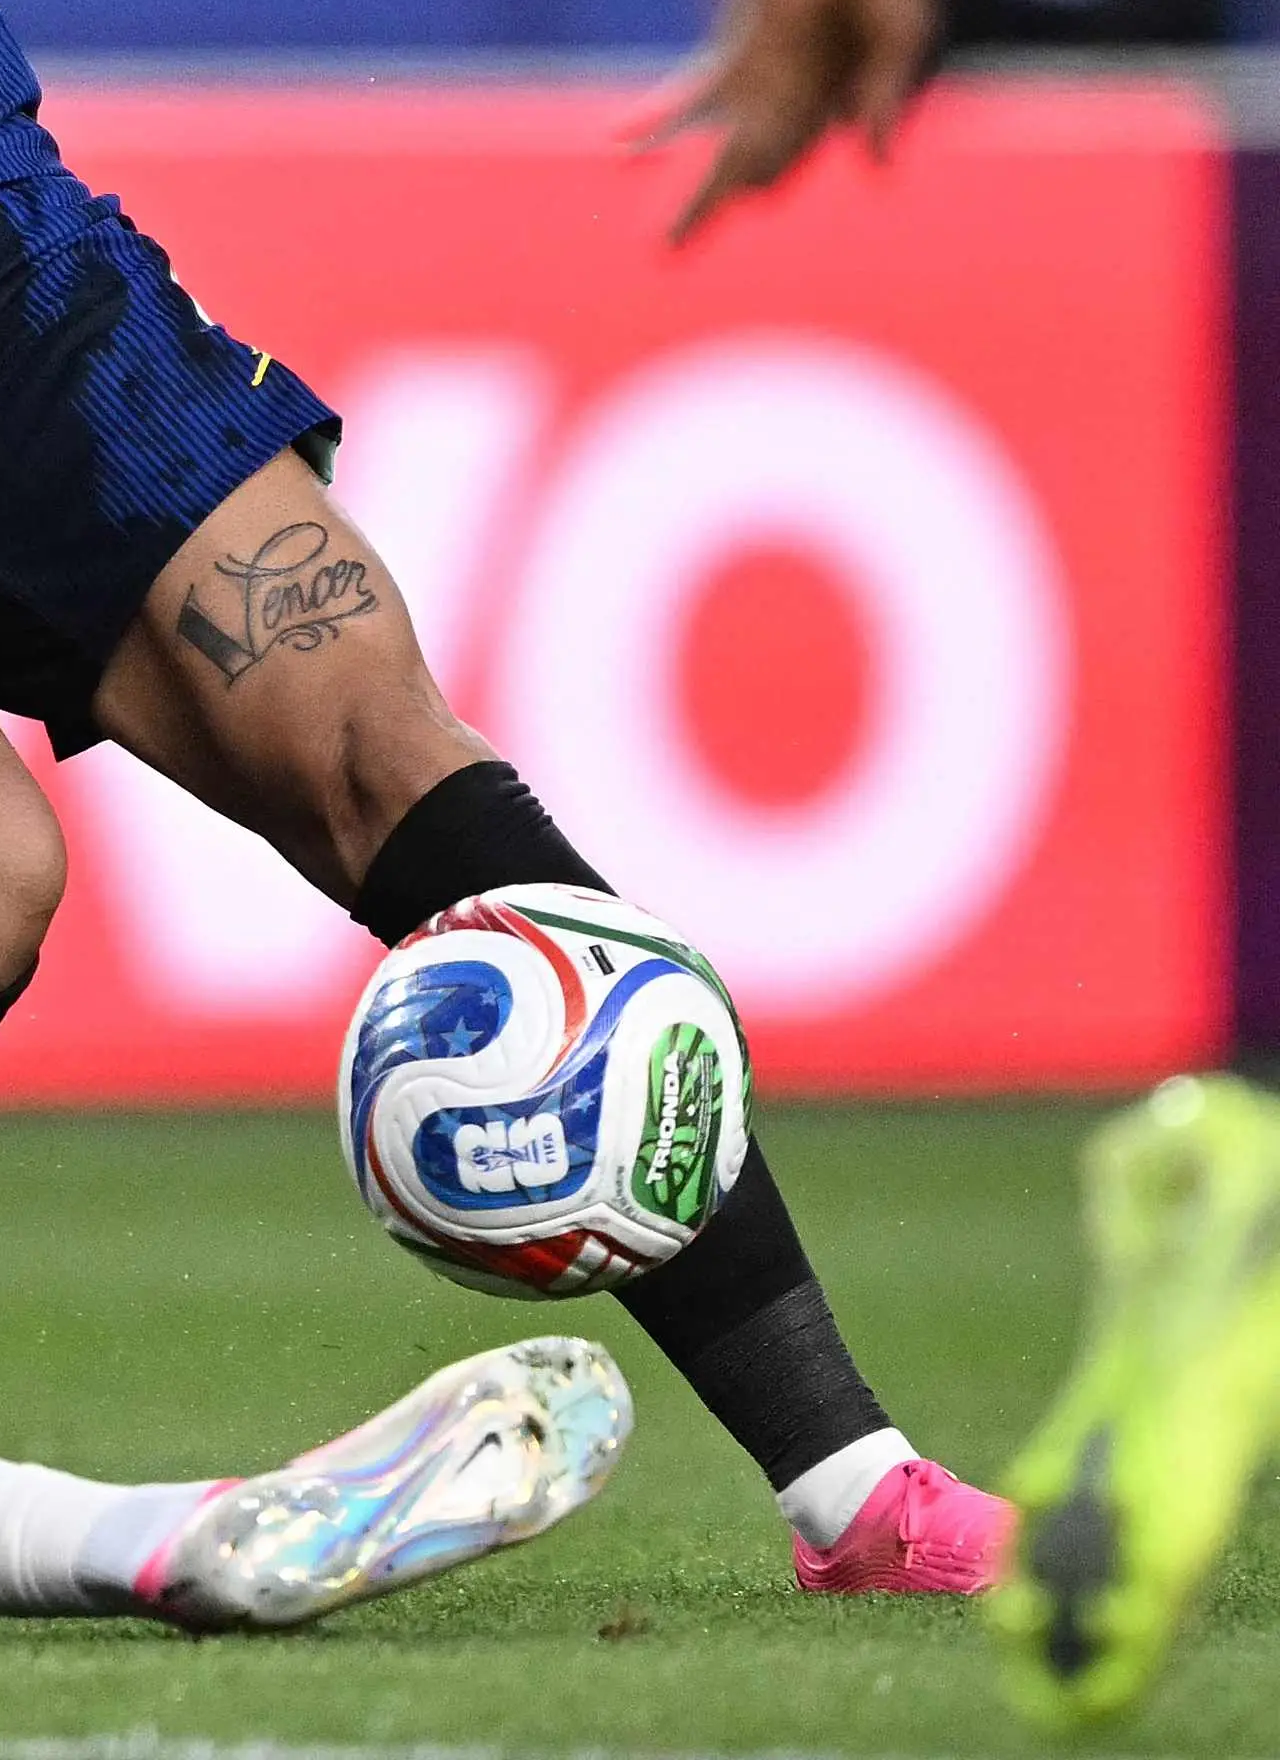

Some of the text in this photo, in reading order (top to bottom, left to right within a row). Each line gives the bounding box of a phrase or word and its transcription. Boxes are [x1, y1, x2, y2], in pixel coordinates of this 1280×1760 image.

[177, 521, 378, 688] Vencer
[543, 1132, 557, 1165] FIFA
[645, 1051, 680, 1184] TRIONDA
